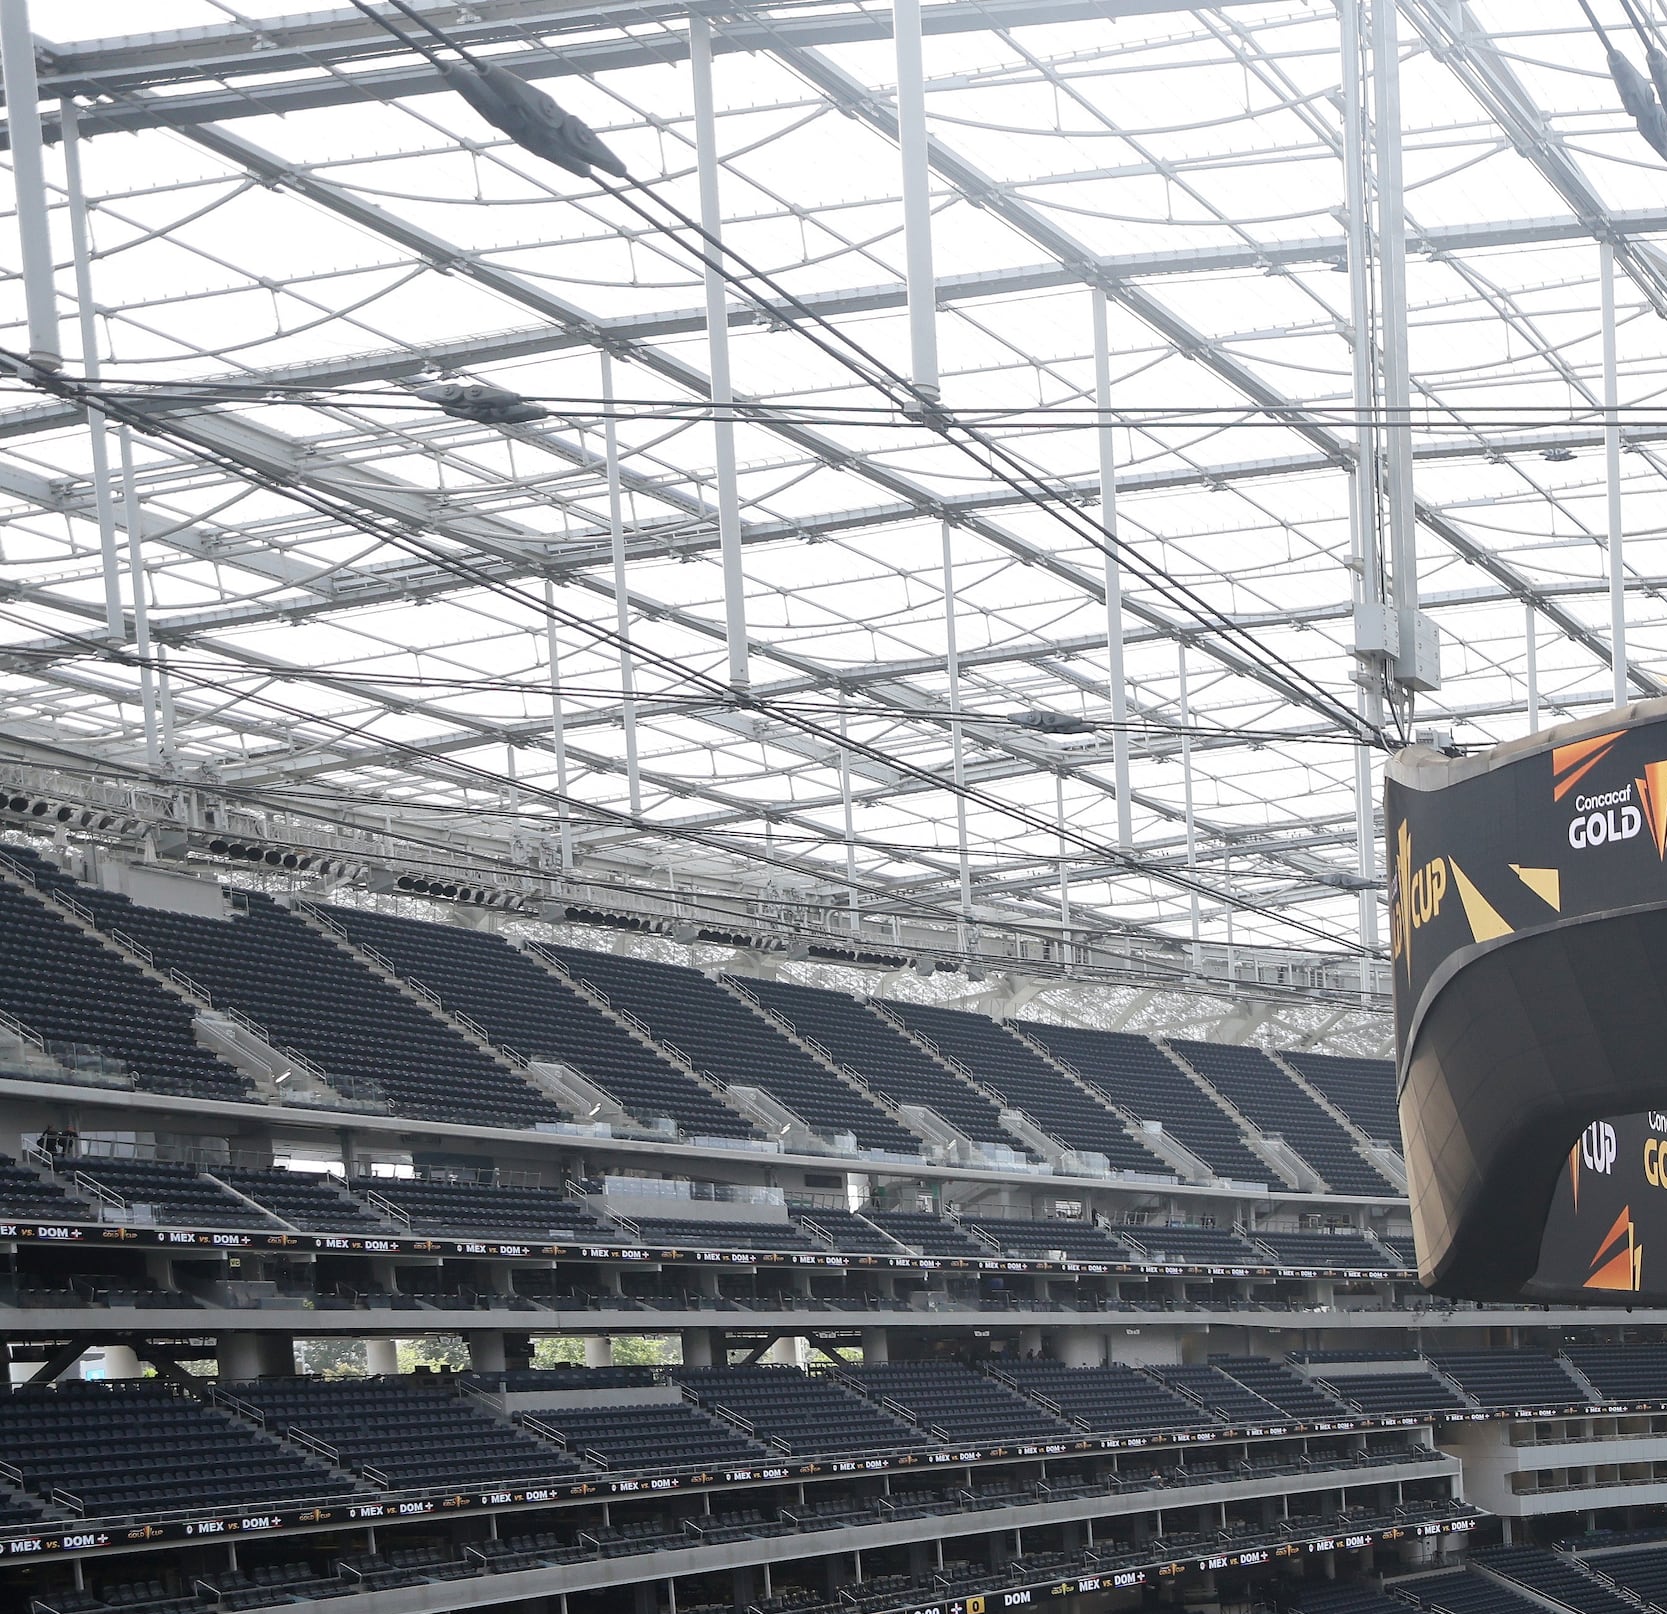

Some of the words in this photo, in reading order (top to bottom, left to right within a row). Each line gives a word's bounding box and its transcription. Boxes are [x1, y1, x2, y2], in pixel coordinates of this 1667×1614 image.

[1575, 785, 1632, 812] Concacaf
[1568, 805, 1641, 849] GOLD
[1411, 856, 1447, 928] CUP
[38, 1227, 68, 1238] DOM
[170, 1233, 195, 1243] MEX
[213, 1234, 239, 1244] DOM
[326, 1238, 349, 1249] MEX
[365, 1240, 388, 1250] DOM
[491, 1492, 512, 1504] MEX
[526, 1489, 549, 1500] DOM
[361, 1505, 384, 1517] MEX
[399, 1502, 424, 1514] DOM
[199, 1520, 224, 1533] MEX
[242, 1517, 269, 1530] DOM
[11, 1538, 42, 1553] MEX
[63, 1534, 95, 1549] DOM
[1316, 1540, 1335, 1553] MEX
[1345, 1534, 1365, 1547] DOM
[1209, 1556, 1228, 1570] MEX
[1240, 1550, 1260, 1565] DOM
[1079, 1578, 1101, 1593] MEX
[1114, 1571, 1136, 1587] DOM
[1004, 1591, 1031, 1607] DOM
